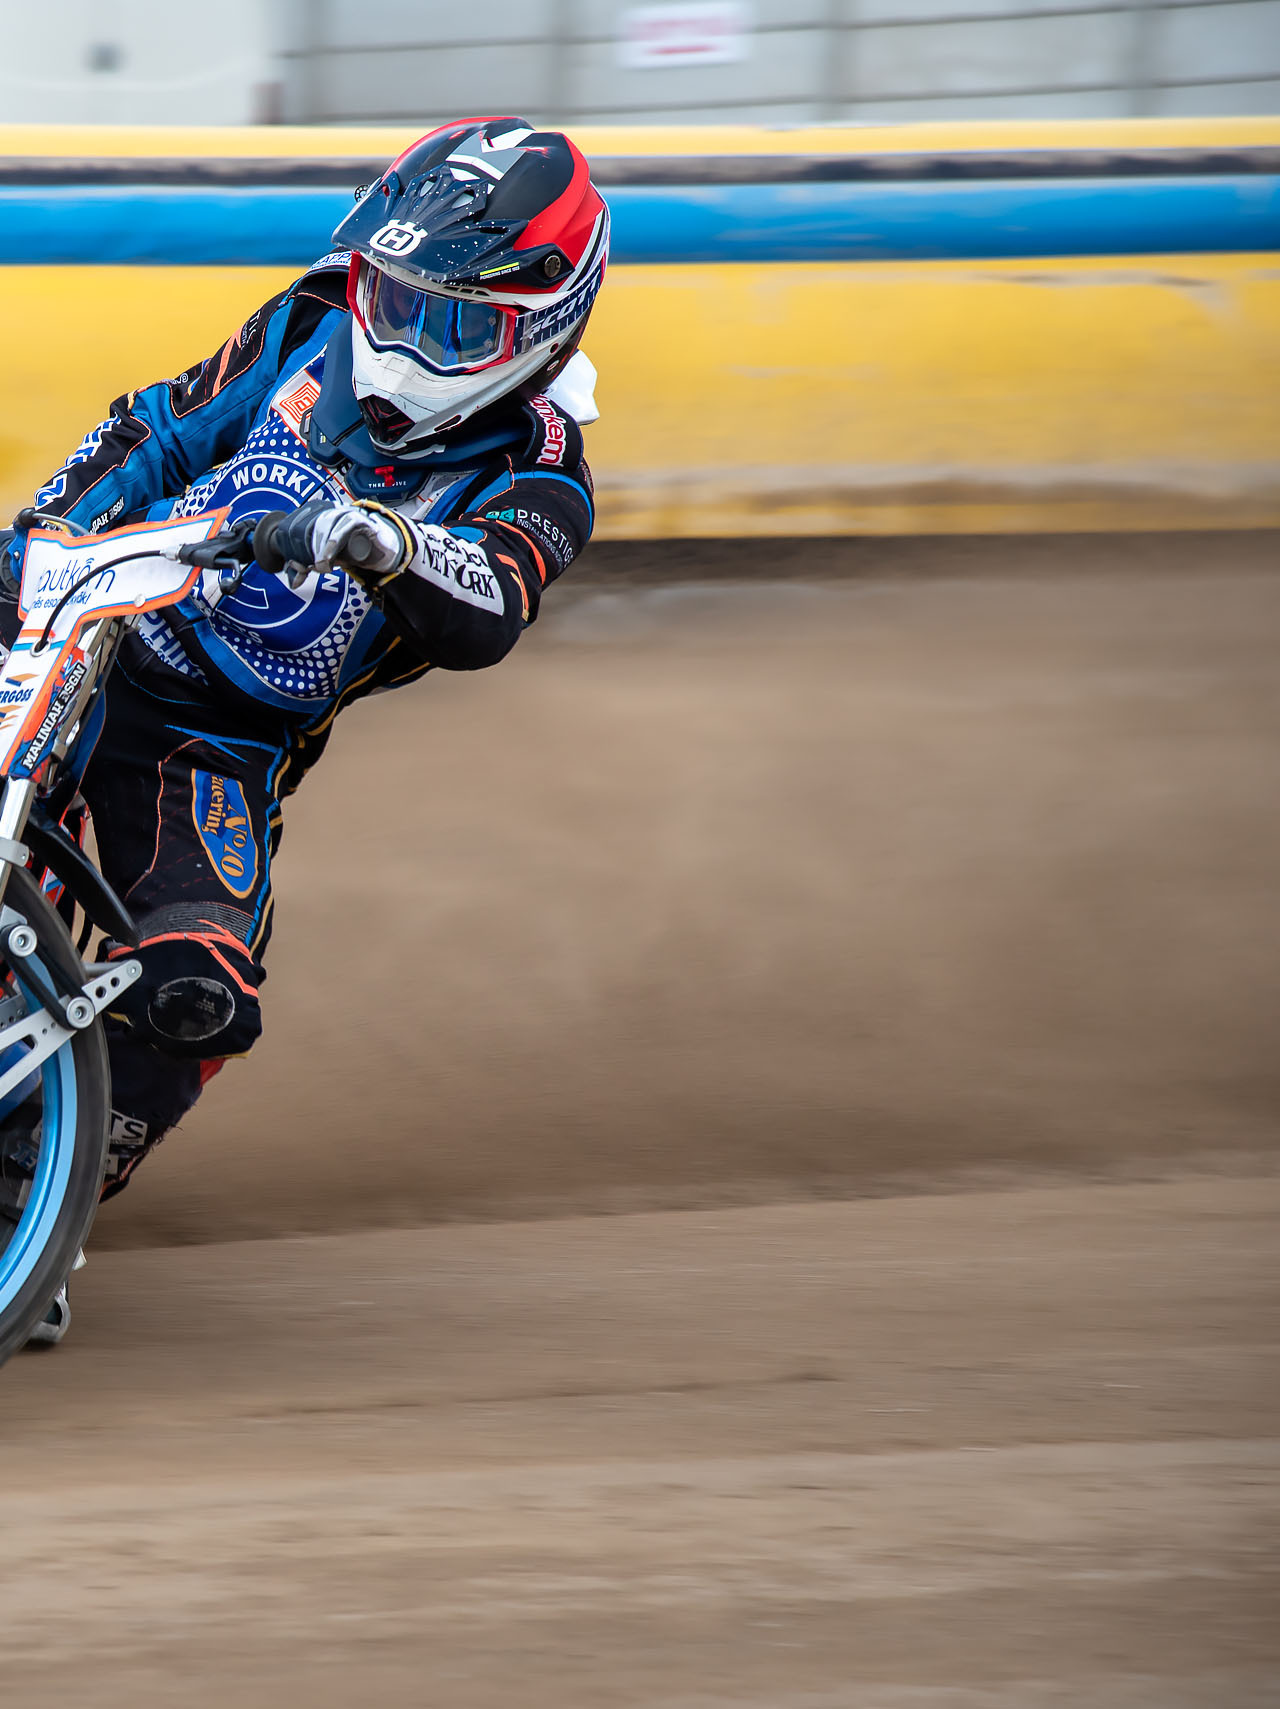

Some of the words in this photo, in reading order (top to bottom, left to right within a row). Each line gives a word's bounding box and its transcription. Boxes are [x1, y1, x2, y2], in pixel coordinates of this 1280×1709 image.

[520, 268, 601, 340] SCOTT
[201, 775, 228, 837] atering
[111, 1111, 144, 1140] TS
